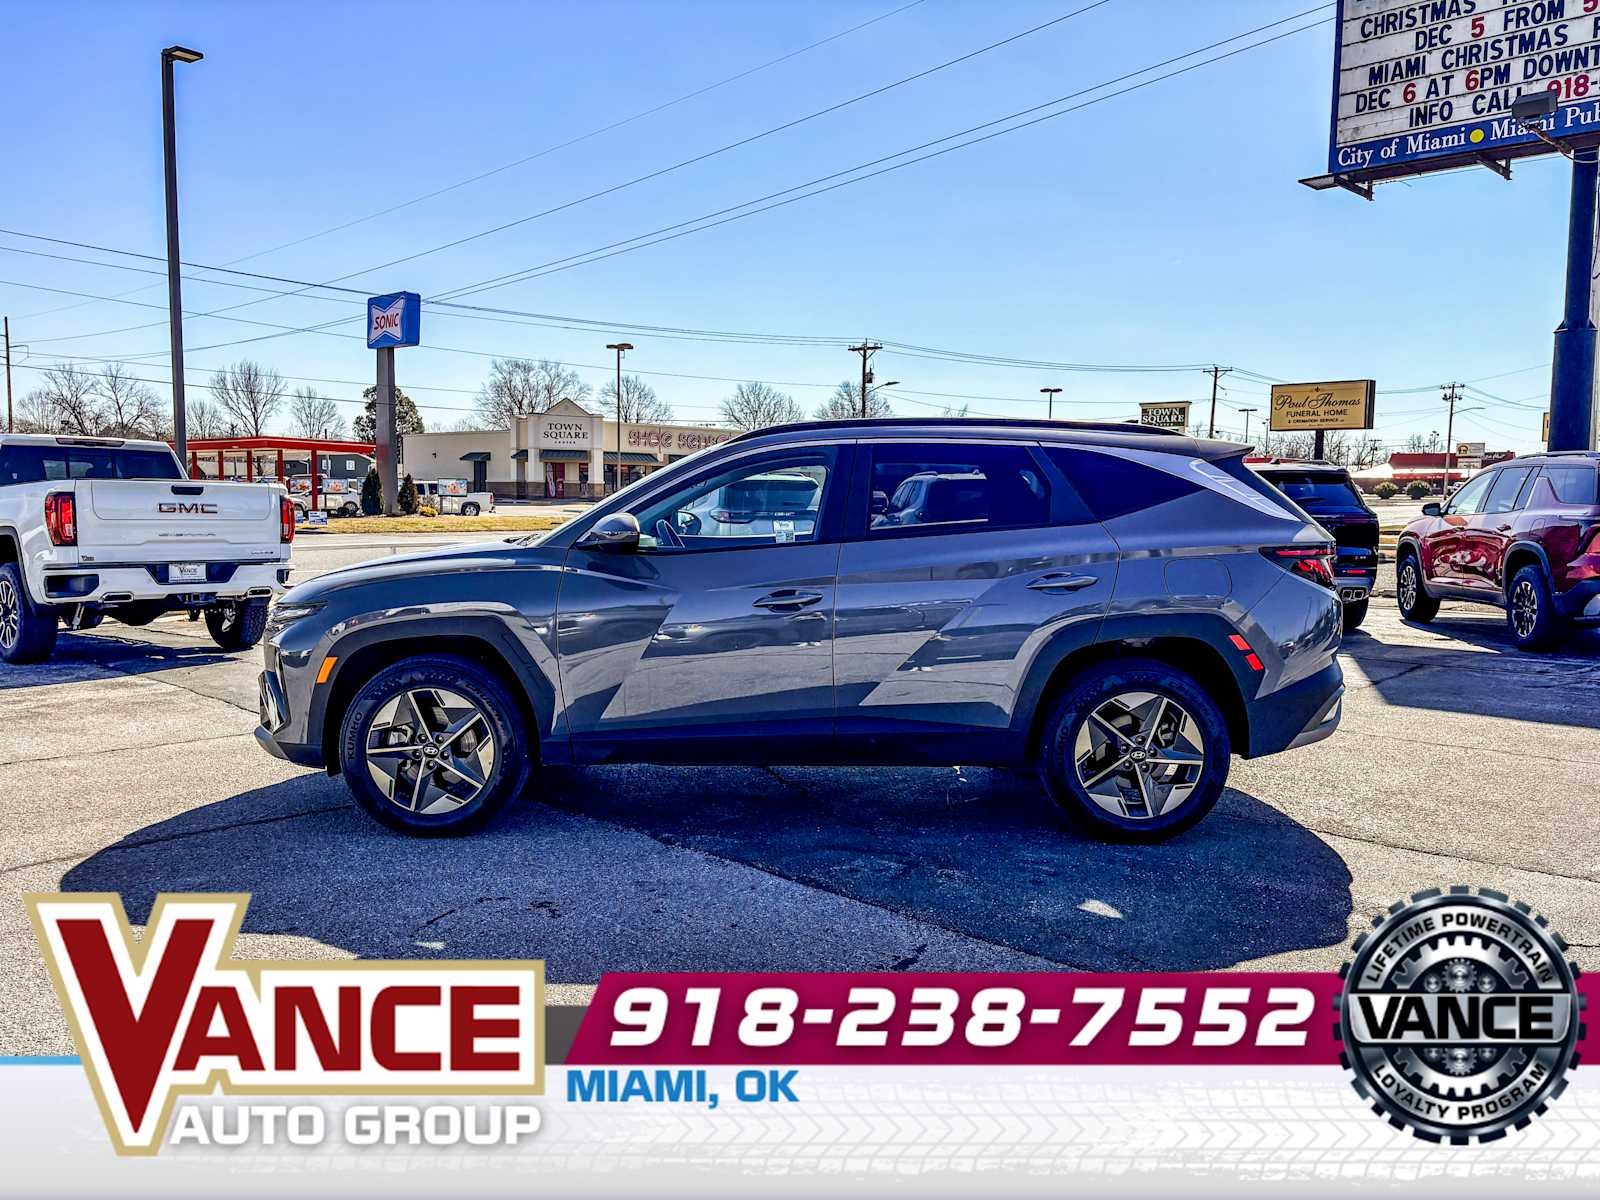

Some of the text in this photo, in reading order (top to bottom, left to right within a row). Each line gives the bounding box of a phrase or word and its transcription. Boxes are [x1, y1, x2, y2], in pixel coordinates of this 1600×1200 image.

[1360, 0, 1477, 39] CHRISTMAS
[1415, 24, 1453, 51] DEC
[1471, 16, 1486, 38] 5
[1503, 0, 1565, 31] FROM
[1368, 55, 1427, 87] MIAMI
[1441, 24, 1569, 71] CHRISTMAS
[1355, 88, 1391, 114] DEC
[1402, 82, 1417, 104] 6
[1425, 75, 1455, 99] AT
[1465, 62, 1511, 91] 6PM
[1409, 100, 1453, 128] INFO
[1338, 148, 1374, 168] City
[1380, 138, 1399, 159] of
[1405, 127, 1466, 155] Miami
[374, 312, 399, 330] SONIC
[1274, 392, 1361, 411] Paul Thomas
[1142, 415, 1184, 424] SQUARE
[1147, 408, 1180, 416] TOWN
[1286, 410, 1320, 418] FUNERAL
[543, 431, 589, 440] SQUARE
[547, 423, 583, 431] TOWN
[158, 503, 218, 514] GMC
[347, 711, 363, 761] KUMHO
